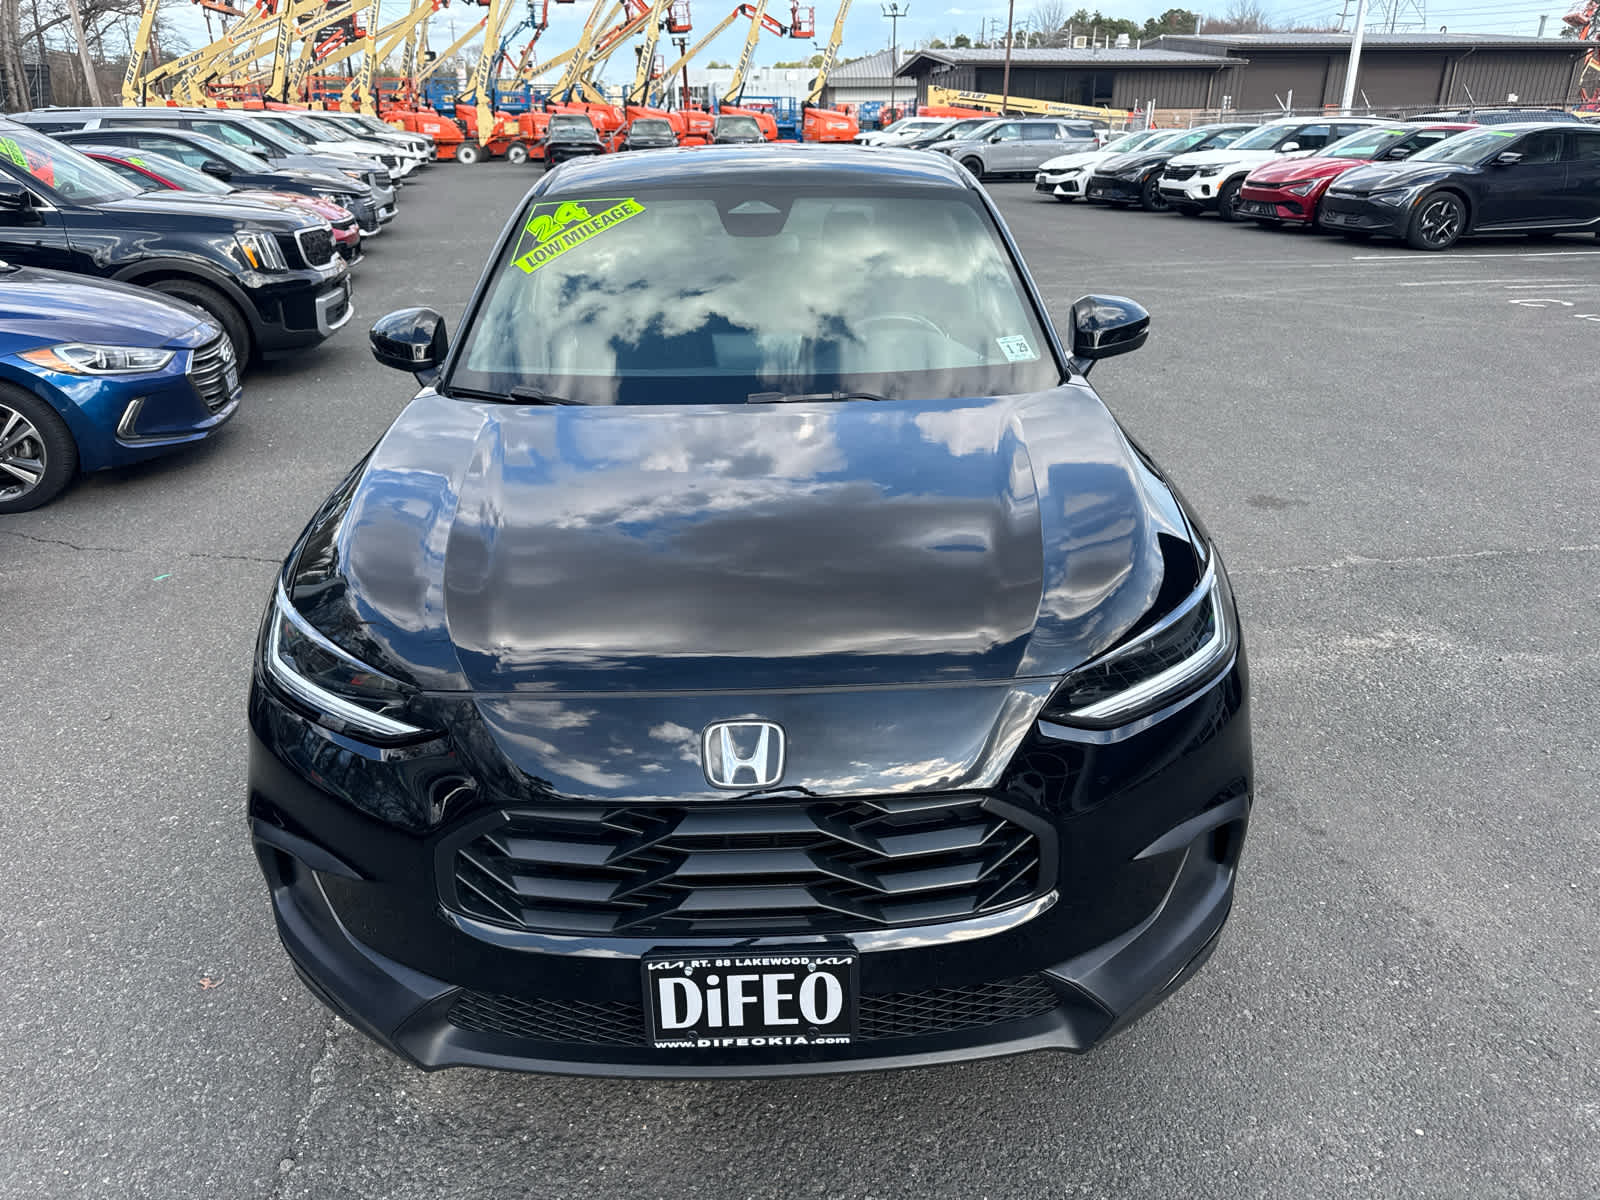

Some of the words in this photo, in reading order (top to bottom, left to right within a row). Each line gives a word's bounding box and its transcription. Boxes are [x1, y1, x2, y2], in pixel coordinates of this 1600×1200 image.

[126, 70, 134, 85] JLG
[132, 50, 140, 69] LIFT
[178, 58, 188, 68] JLG
[190, 52, 204, 62] LIFT
[242, 50, 255, 60] LIFT
[526, 202, 592, 242] 24
[525, 240, 562, 268] LOW
[562, 204, 632, 246] MILEAGE
[691, 958, 712, 968] RT.
[735, 956, 809, 967] LAKEWOOD
[658, 971, 844, 1030] DiFEO
[654, 1036, 850, 1049] www.DIFEOKIA.com
